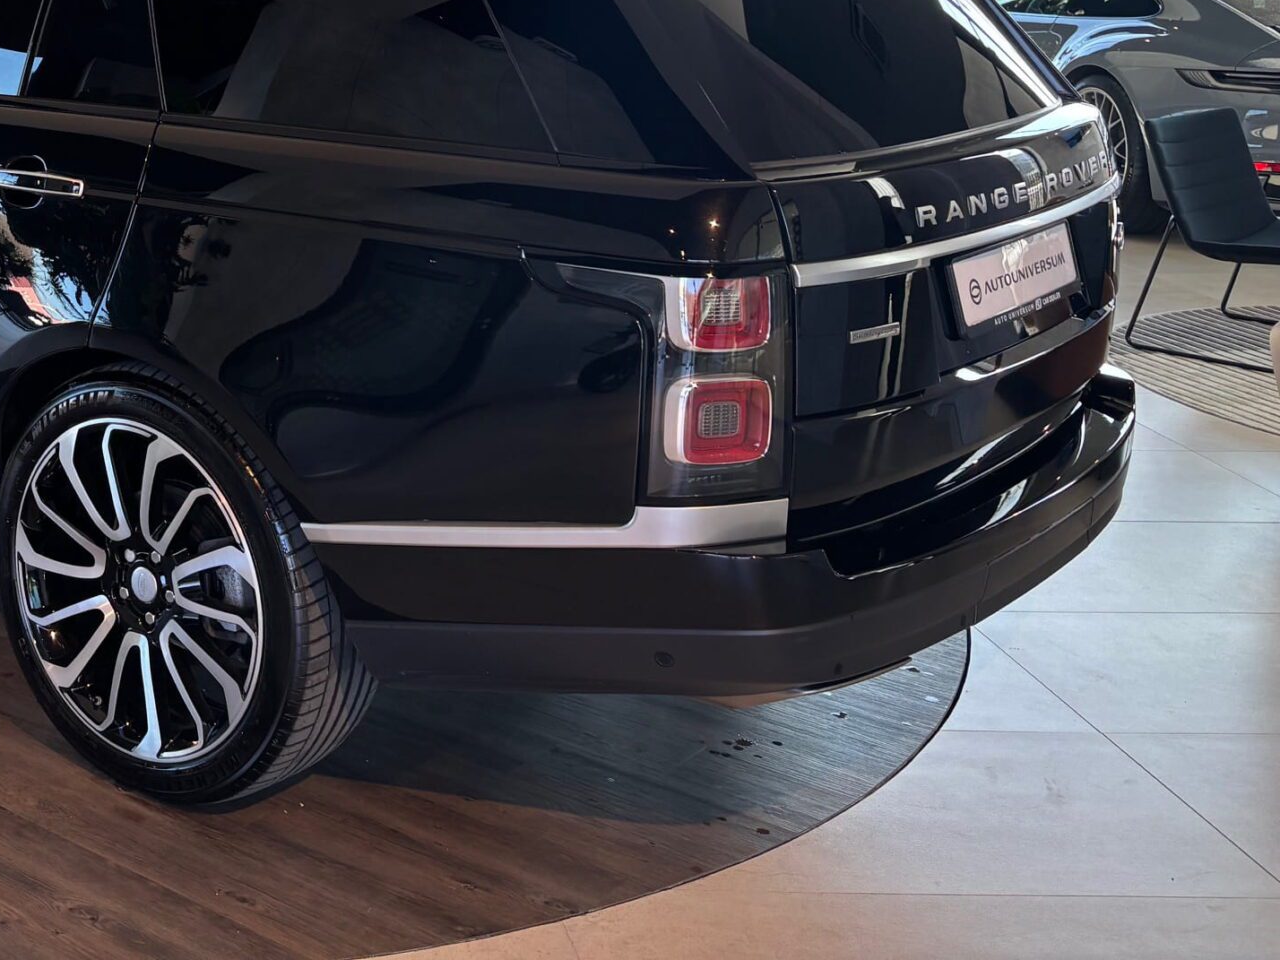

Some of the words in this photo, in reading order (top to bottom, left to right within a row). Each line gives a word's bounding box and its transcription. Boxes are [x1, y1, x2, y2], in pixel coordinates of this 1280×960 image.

[915, 181, 1028, 228] RANGE
[1044, 150, 1108, 192] ROVER
[984, 251, 1066, 295] AUTOUNIVERSUM
[994, 314, 1008, 325] AUTO
[31, 391, 109, 440] MICHELIN
